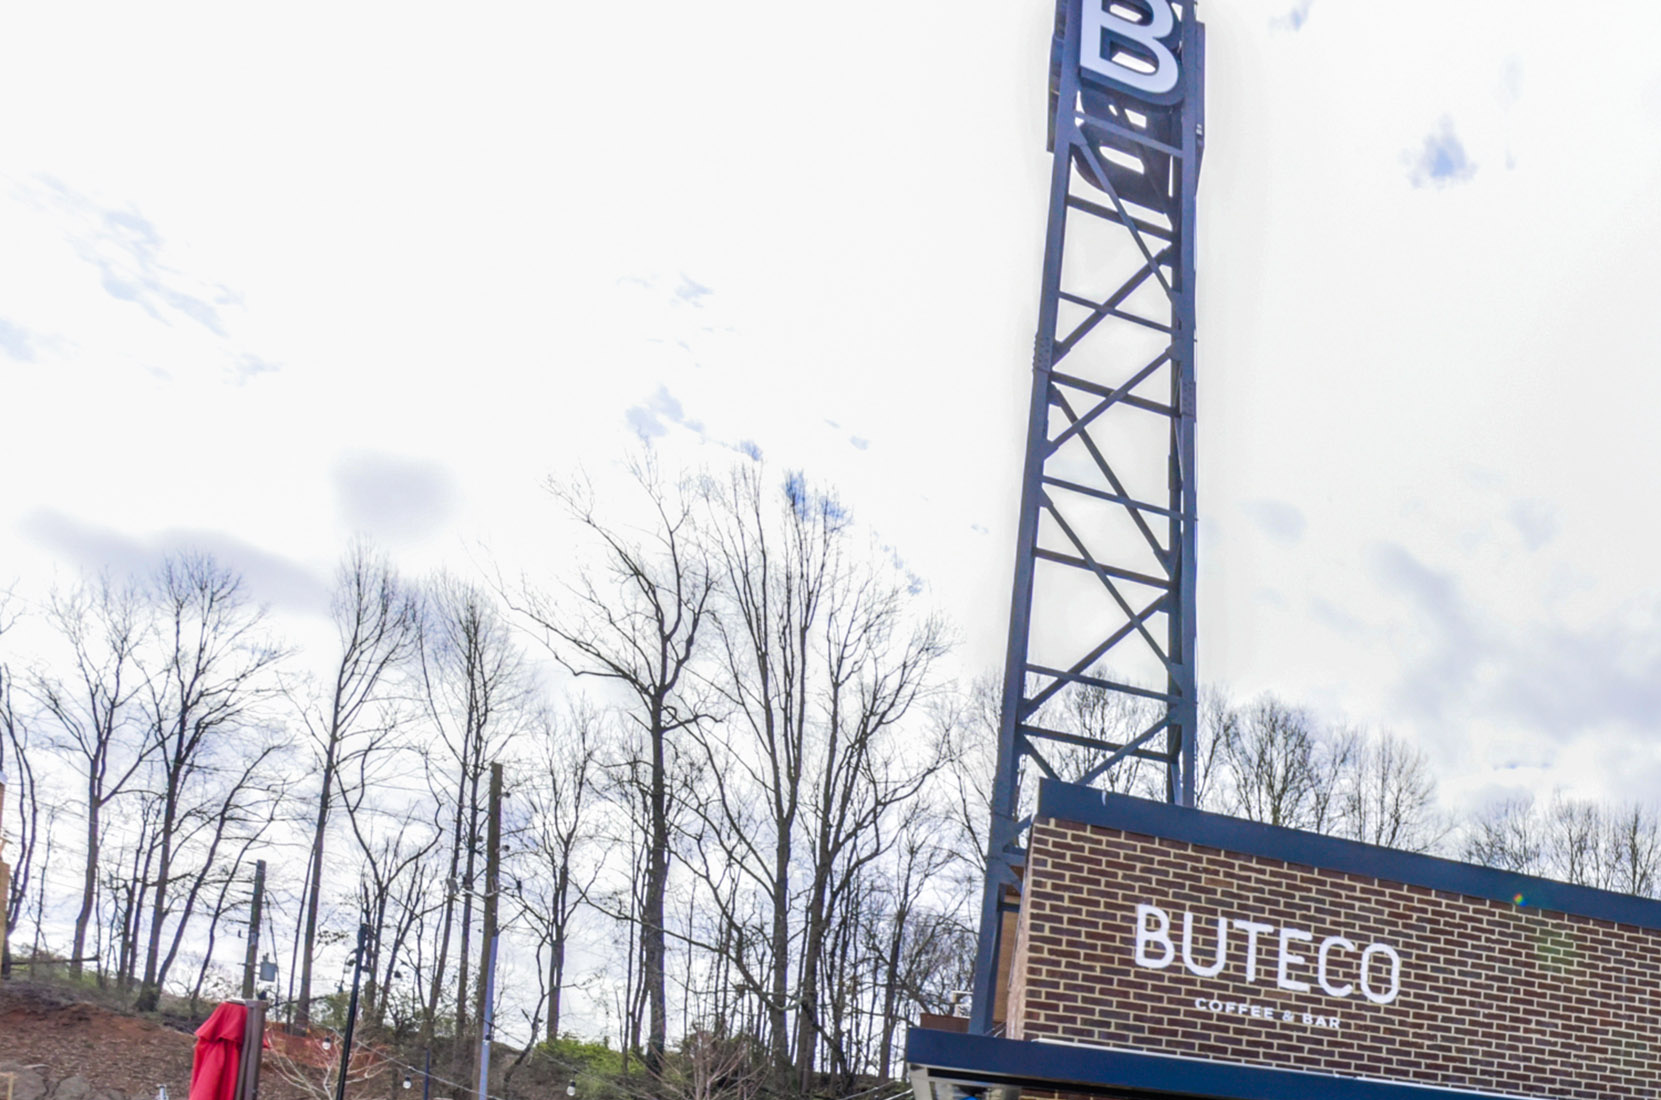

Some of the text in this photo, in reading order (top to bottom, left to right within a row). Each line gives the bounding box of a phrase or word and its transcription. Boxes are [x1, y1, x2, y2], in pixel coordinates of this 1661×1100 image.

[1080, 0, 1178, 93] B
[1135, 904, 1400, 1004] BUTECO
[1194, 997, 1341, 1029] COFFEE & BAR
